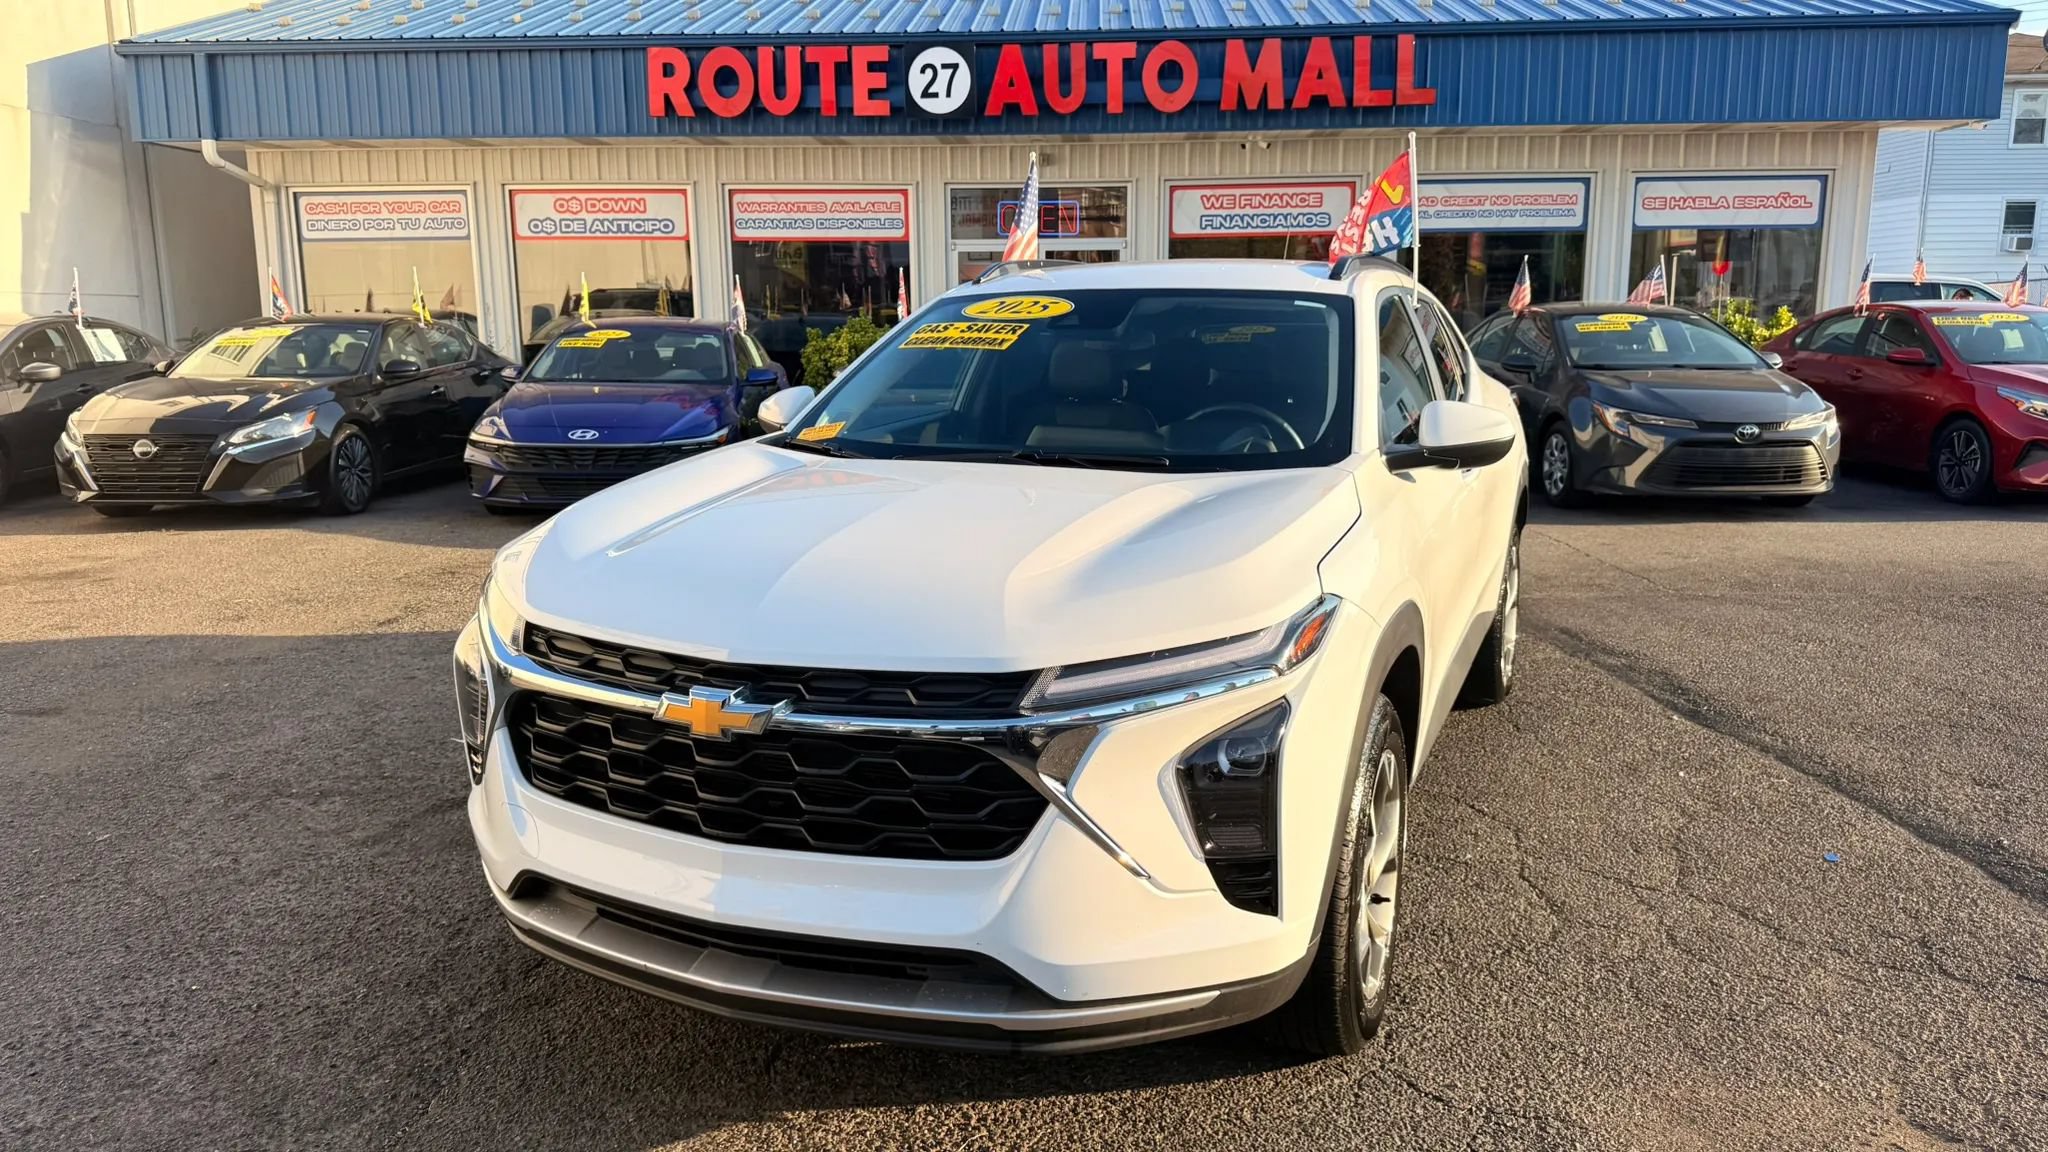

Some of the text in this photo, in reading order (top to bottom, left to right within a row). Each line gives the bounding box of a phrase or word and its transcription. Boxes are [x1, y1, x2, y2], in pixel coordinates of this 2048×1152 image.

[647, 34, 1437, 117] ROUTE 27 AUTO MALL
[305, 200, 461, 215] CASH FOR YOUR CAR
[585, 197, 647, 214] DOWN
[736, 201, 901, 213] WARRANTIES AVAILABLE
[1200, 192, 1323, 209] WE FINANCE
[1418, 194, 1578, 207] AD CREDIT NO PROBLEM
[1642, 192, 1813, 210] SE HABLA ESPAÑOL
[1000, 204, 1076, 233] OEN
[1200, 212, 1331, 230] FINANCIAMOS
[1418, 208, 1576, 219] AL CREDITO NO HAY PROBLEMA
[307, 217, 466, 231] DINERO POR TU AUTO
[559, 218, 587, 234] DE
[588, 218, 675, 234] ANTICIPO
[735, 217, 903, 230] GARANTIAS DISPONIBLES
[977, 300, 1061, 315] 2025
[914, 323, 952, 335] GAS
[960, 323, 1025, 336] SAVER
[903, 336, 1012, 348] CLEAN CARFAX
